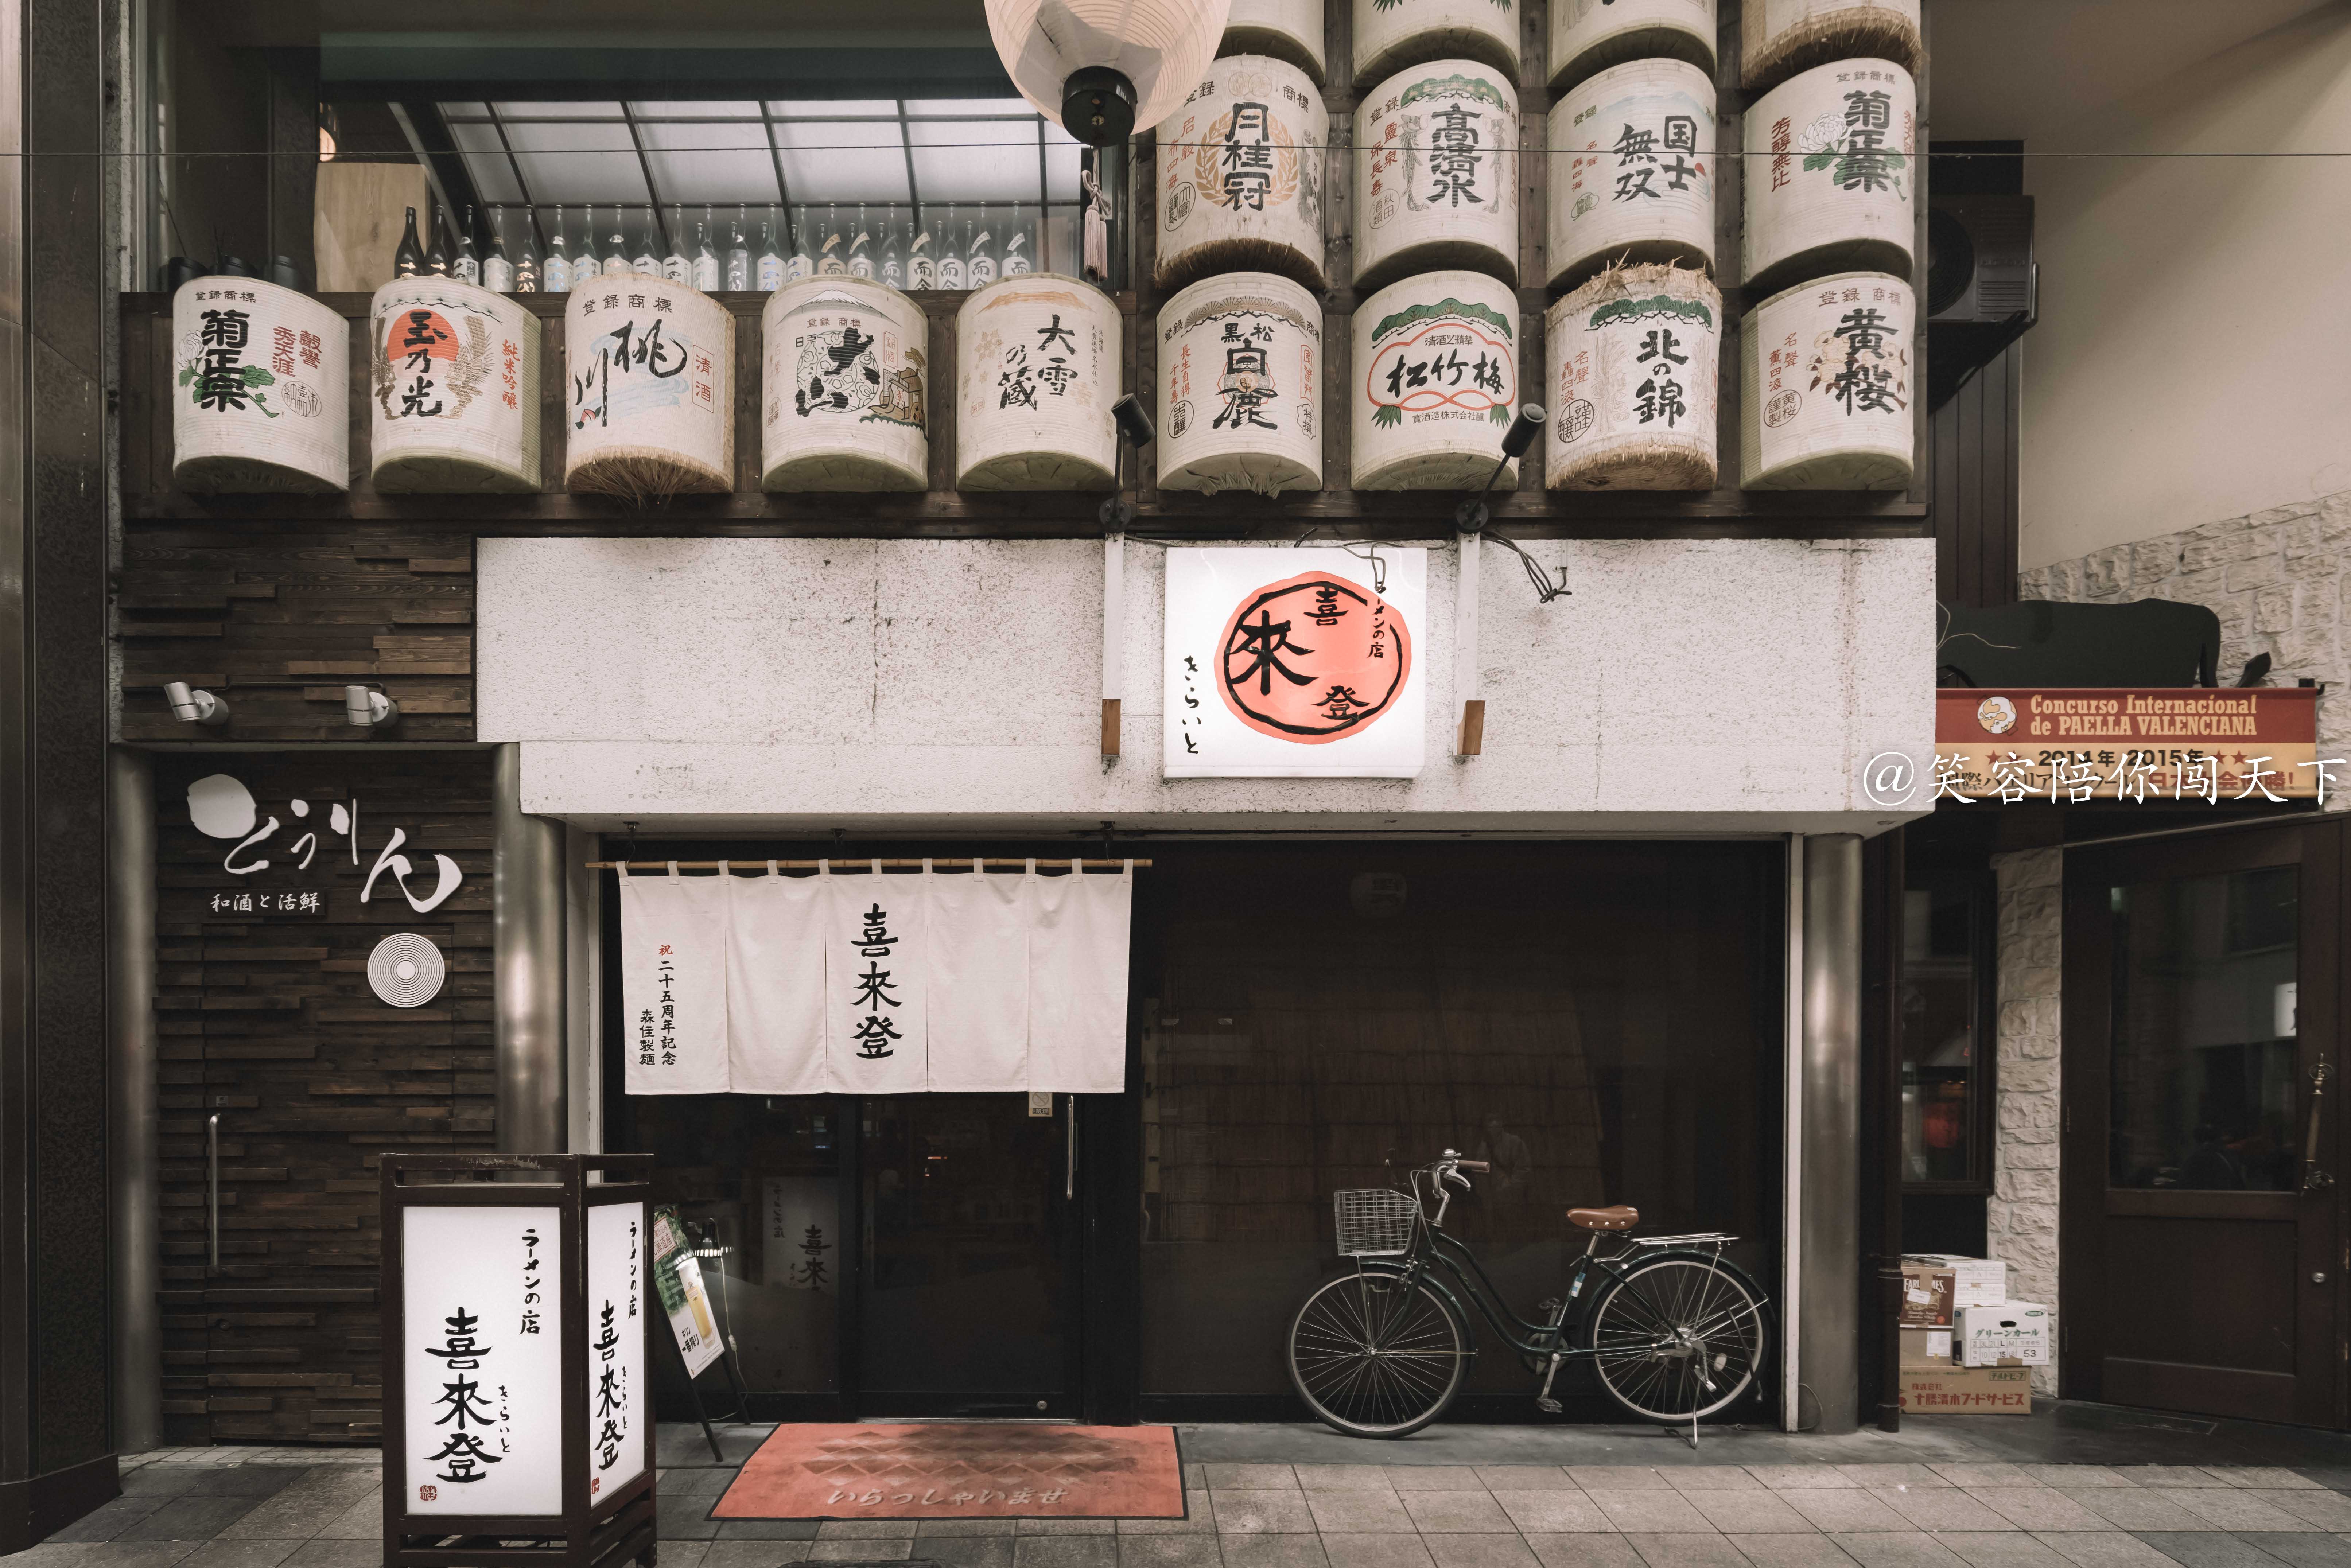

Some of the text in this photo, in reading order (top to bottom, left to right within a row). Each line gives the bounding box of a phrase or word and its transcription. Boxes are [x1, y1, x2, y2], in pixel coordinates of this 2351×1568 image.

[1221, 102, 1273, 211] 月桂冠
[1426, 102, 1485, 208] 高清水
[1611, 123, 1661, 202] 無双
[1660, 115, 1697, 191] 国士
[1771, 116, 1791, 192] 芳醇無比
[1842, 90, 1892, 193] 菊正宗
[583, 294, 672, 316] 登録商標
[807, 317, 862, 328] 登録商標
[1818, 288, 1901, 308] 登録商標
[200, 309, 250, 413] 菊正宗
[400, 311, 448, 417] 玉乃光
[1037, 314, 1078, 396] 大雪
[1221, 322, 1275, 343] 黒松
[696, 354, 712, 402] 清酒
[1386, 348, 1505, 398] 松竹梅
[1632, 329, 1689, 428] 北の錦
[2030, 694, 2257, 715] Concurso Internacional
[2030, 716, 2257, 736] de PAELLA VALENCIANA
[210, 892, 320, 913] 和酒と活鮮
[519, 1228, 540, 1335] ラーメンの店
[628, 1221, 638, 1319] ラーメンの店
[1975, 1328, 2040, 1338] グリーンカール
[498, 1385, 511, 1453] きらいと
[1914, 1393, 2025, 1406] 十勝清水フードサービス
[827, 1488, 1069, 1506] いらっしゃいませ
